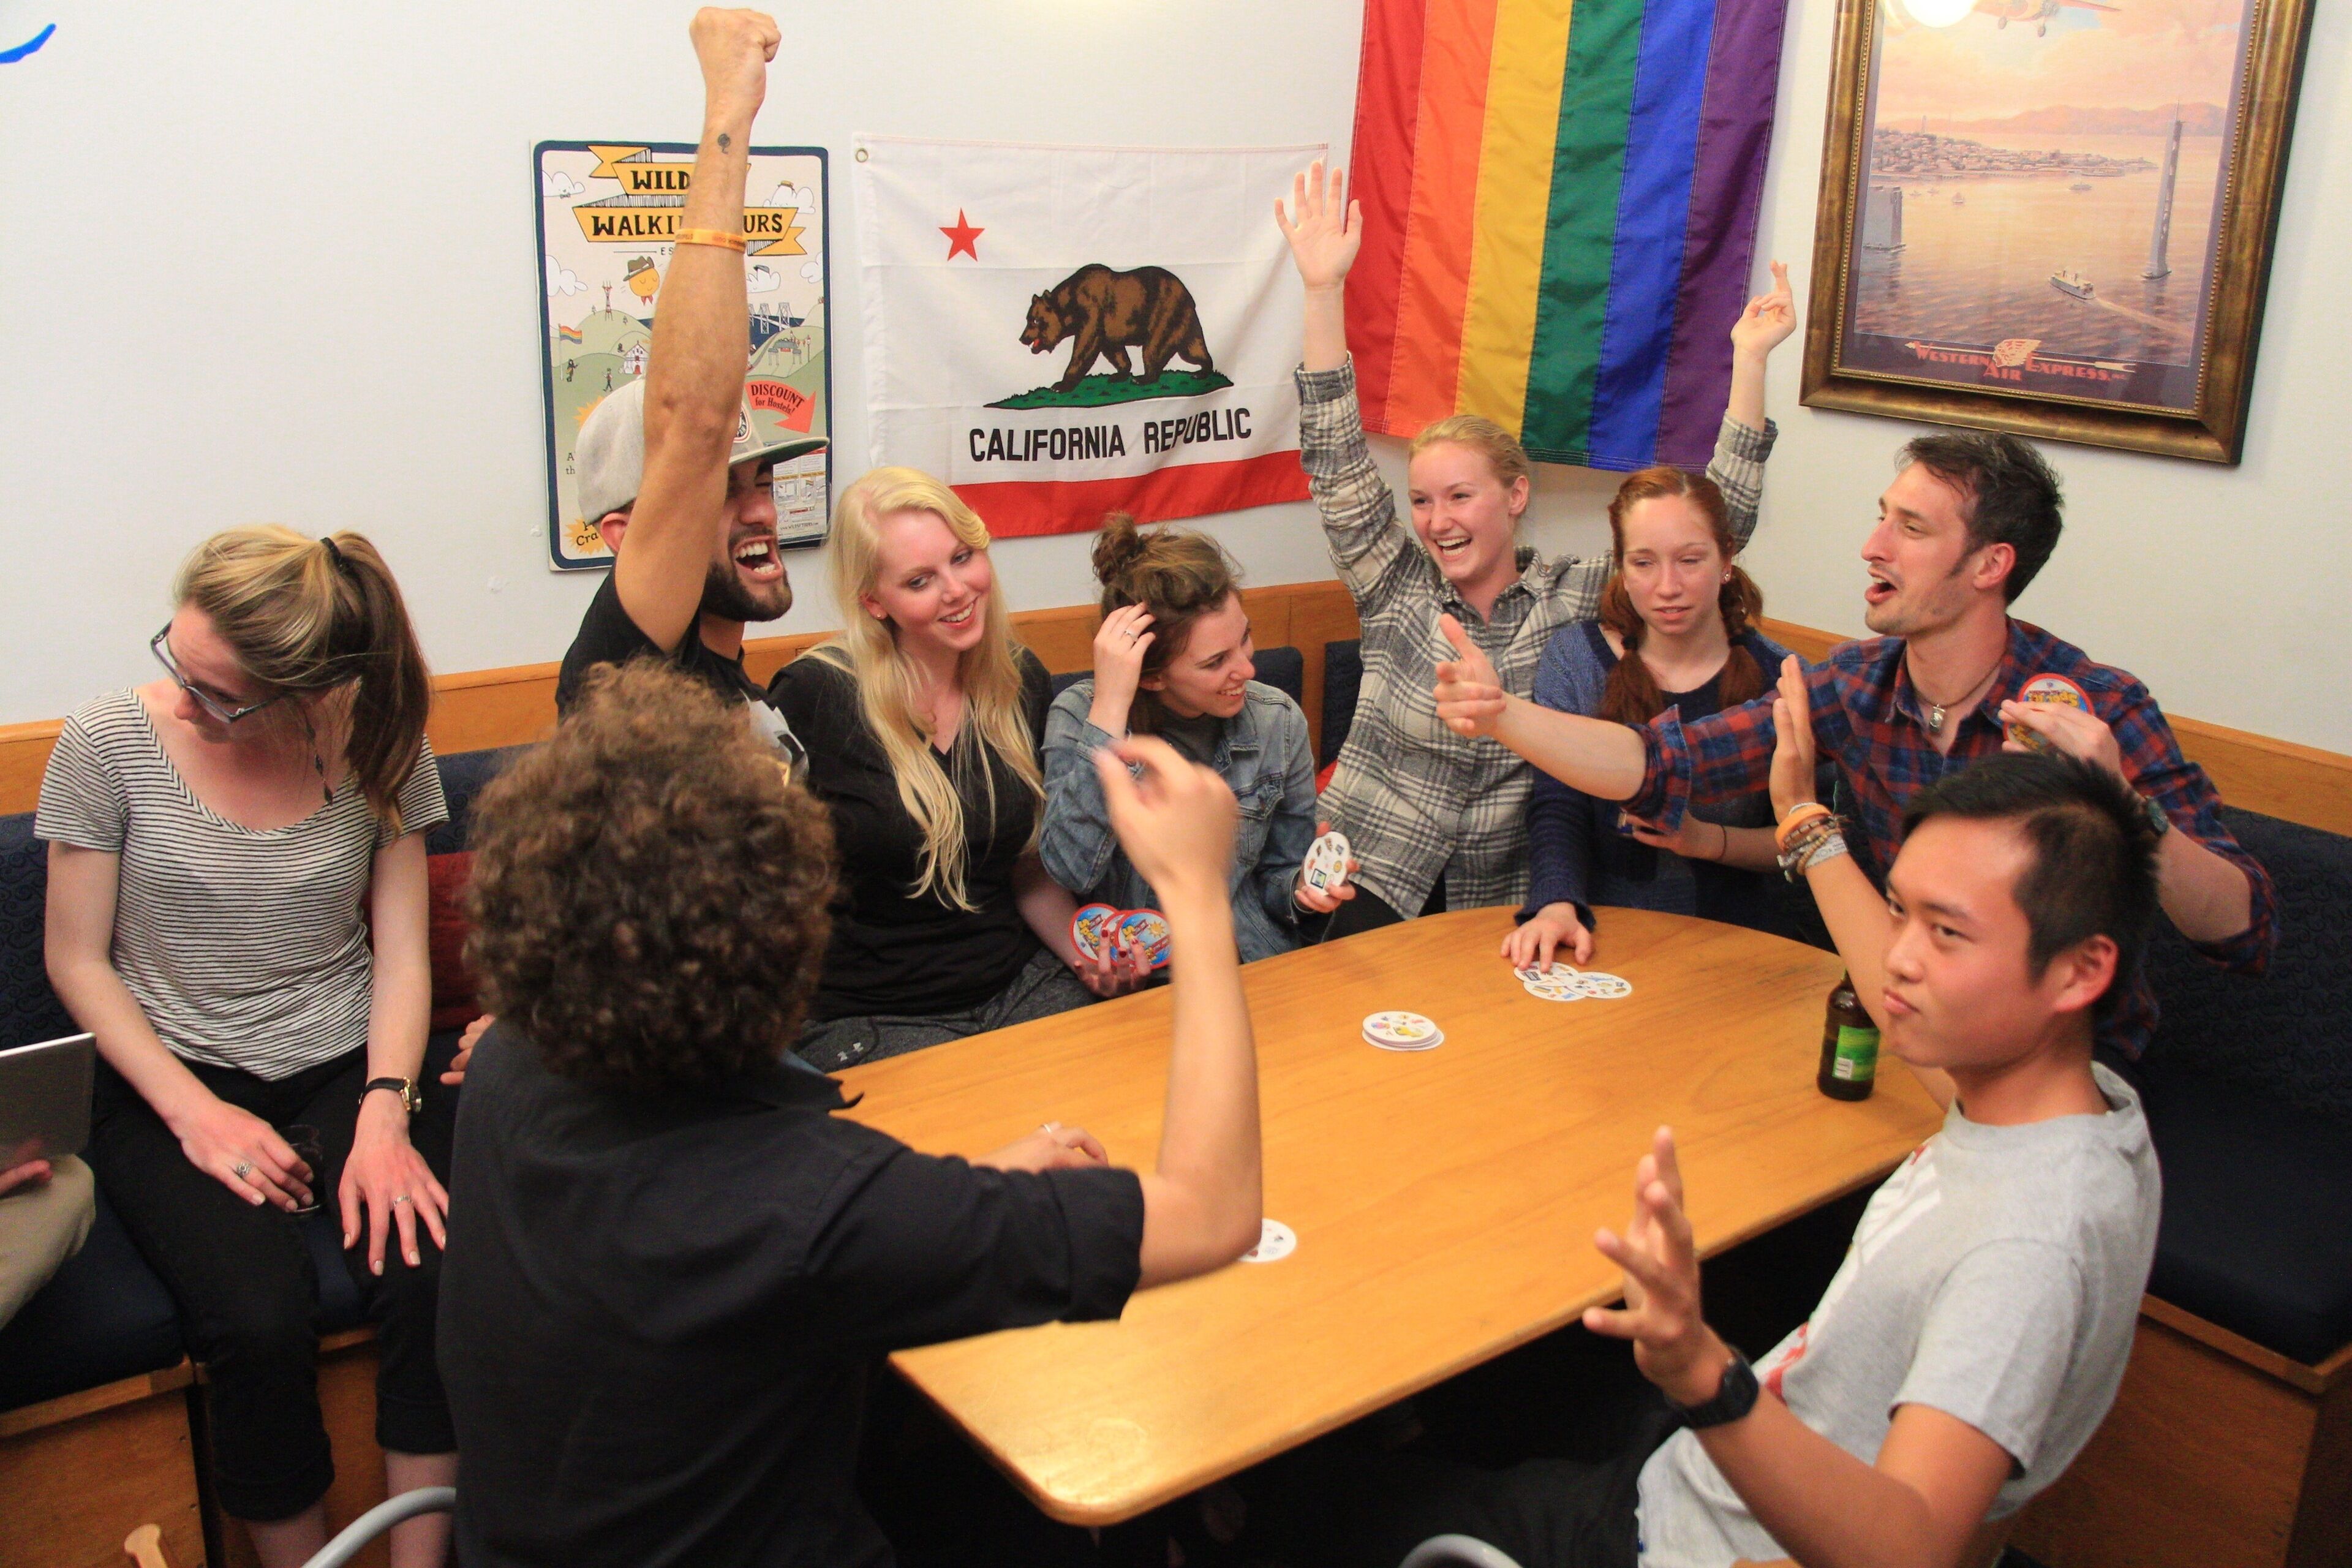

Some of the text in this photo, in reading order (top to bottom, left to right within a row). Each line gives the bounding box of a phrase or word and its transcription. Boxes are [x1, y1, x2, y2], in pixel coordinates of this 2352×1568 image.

[630, 170, 690, 190] WILD
[591, 213, 783, 236] WALKI URS
[660, 247, 674, 255] ES
[751, 384, 805, 408] DISCOUNT
[755, 397, 795, 415] for Hostels!
[969, 407, 1252, 462] CALIFORNIA REPUBLIC
[576, 531, 599, 546] Cra
